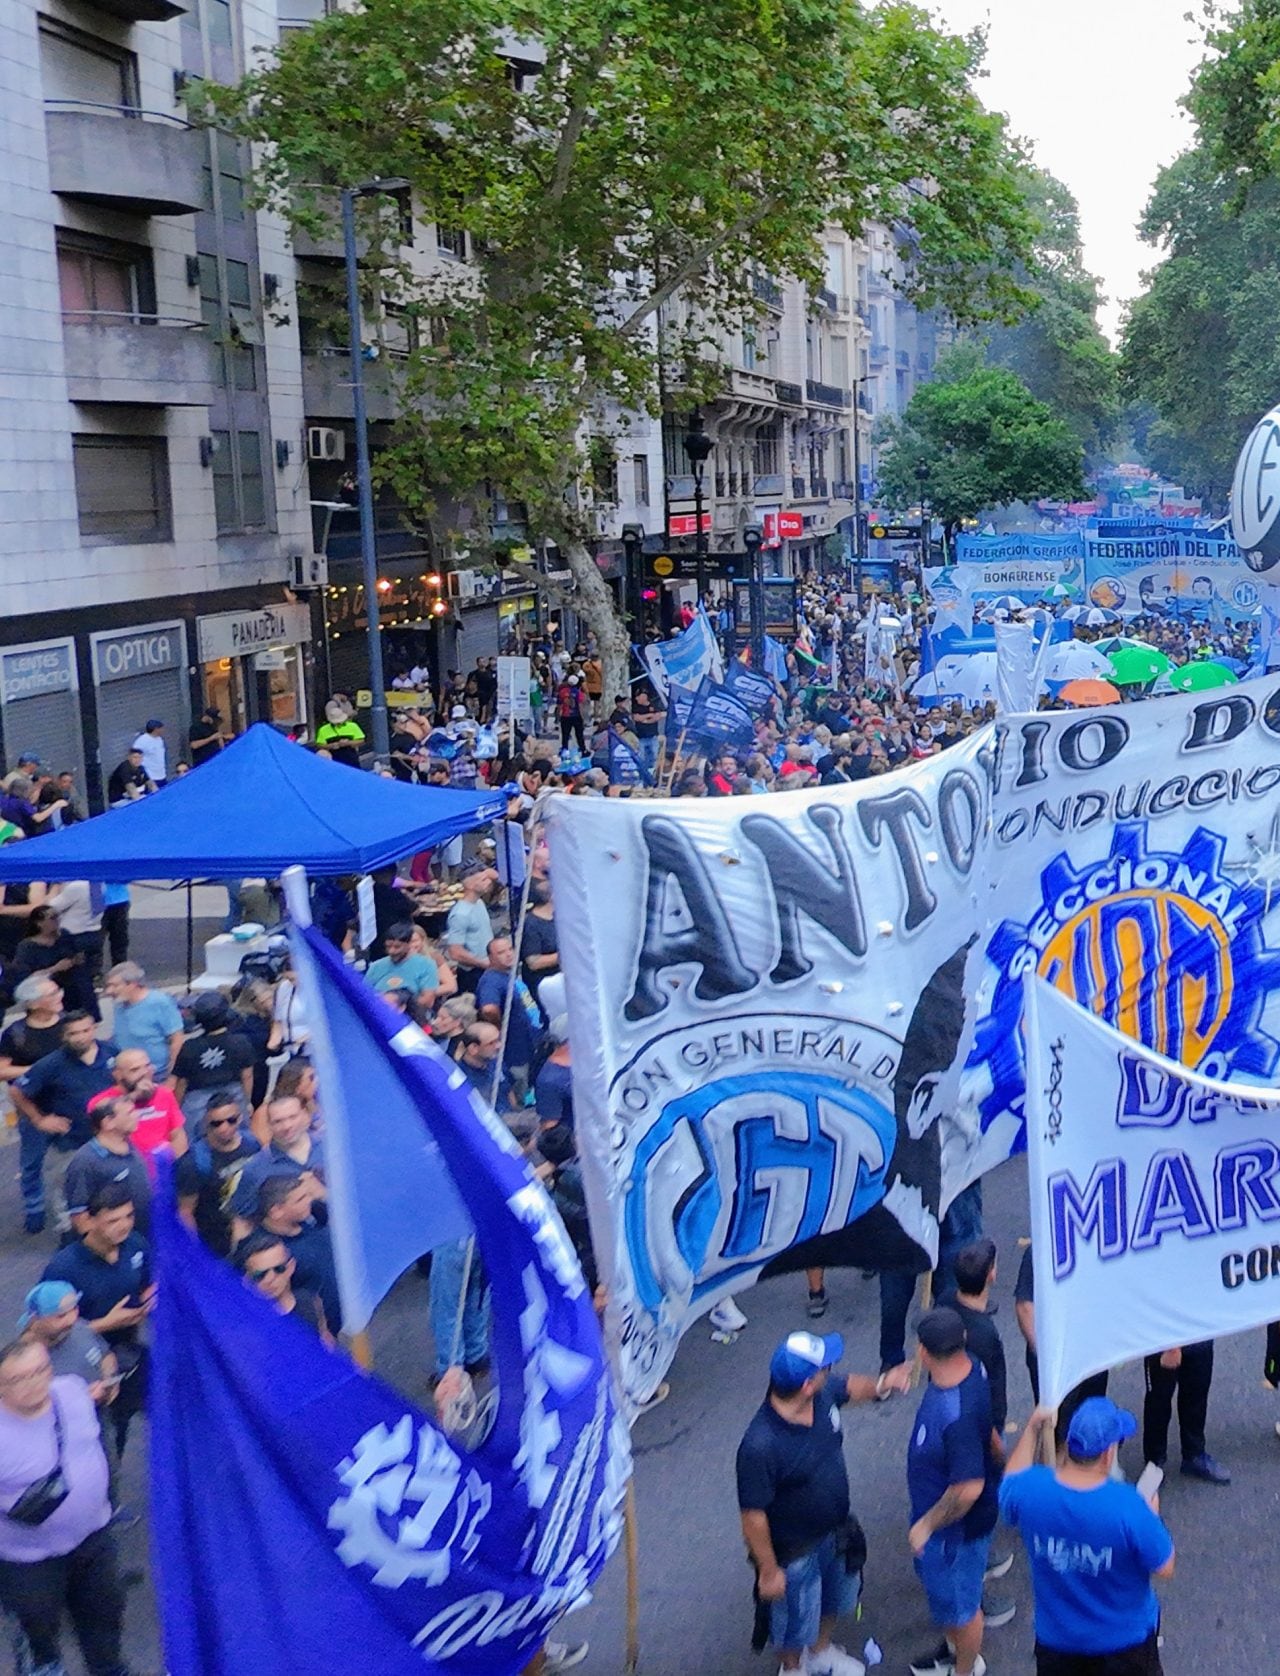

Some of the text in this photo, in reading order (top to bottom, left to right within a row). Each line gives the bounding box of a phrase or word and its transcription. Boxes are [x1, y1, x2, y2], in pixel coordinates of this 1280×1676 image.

[1185, 541, 1213, 558] DEL
[983, 571, 1056, 583] BONAERENSE
[1008, 854, 1247, 981] SECCIONAL
[682, 1029, 864, 1072] GENERAL
[644, 1091, 886, 1293] CGT
